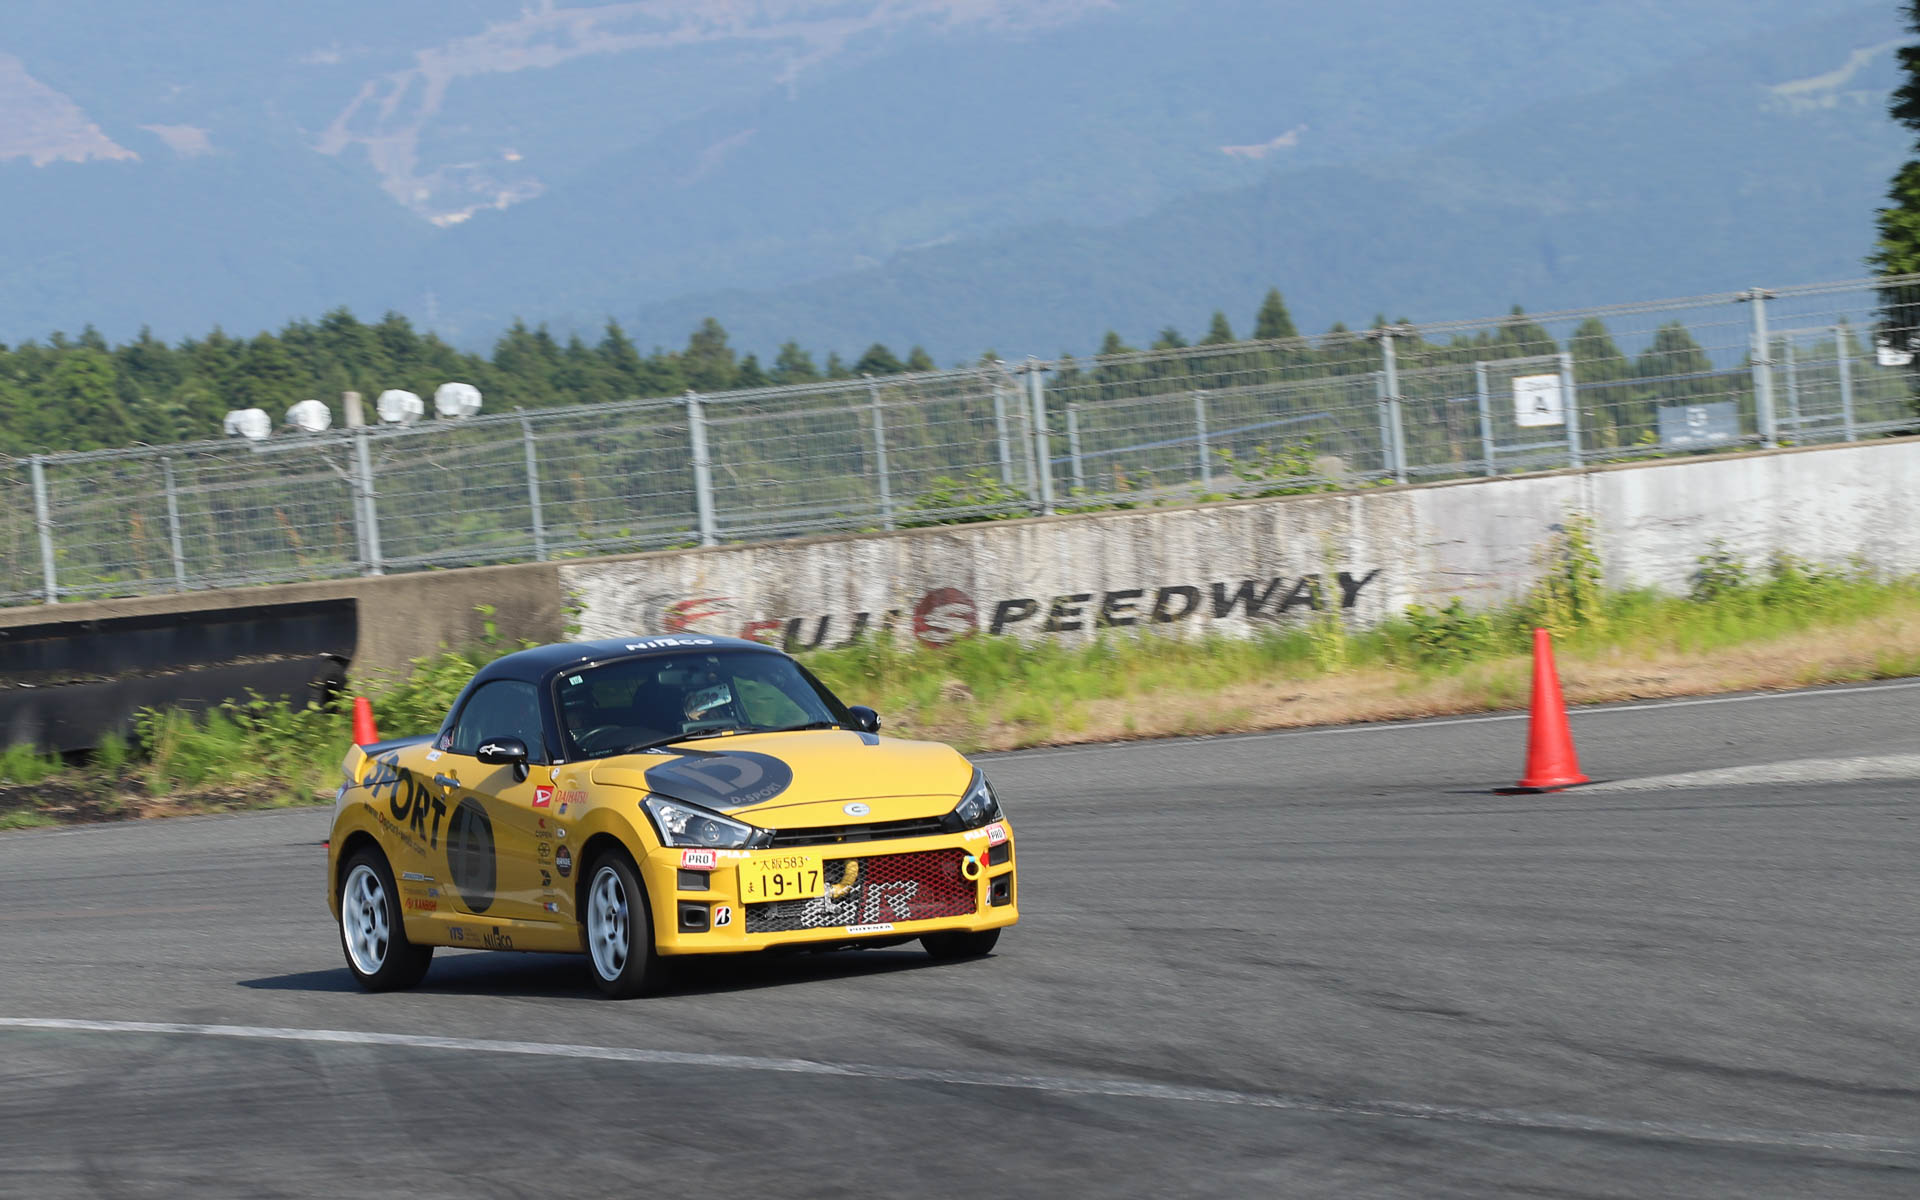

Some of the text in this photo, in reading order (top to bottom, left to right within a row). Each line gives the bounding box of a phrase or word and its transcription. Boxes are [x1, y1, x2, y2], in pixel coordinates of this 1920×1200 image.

[555, 790, 588, 804] DAIHATSU
[730, 782, 782, 805] D-SPORT
[988, 829, 1003, 840] PRO
[688, 854, 709, 865] PRO
[762, 870, 818, 896] 19-17
